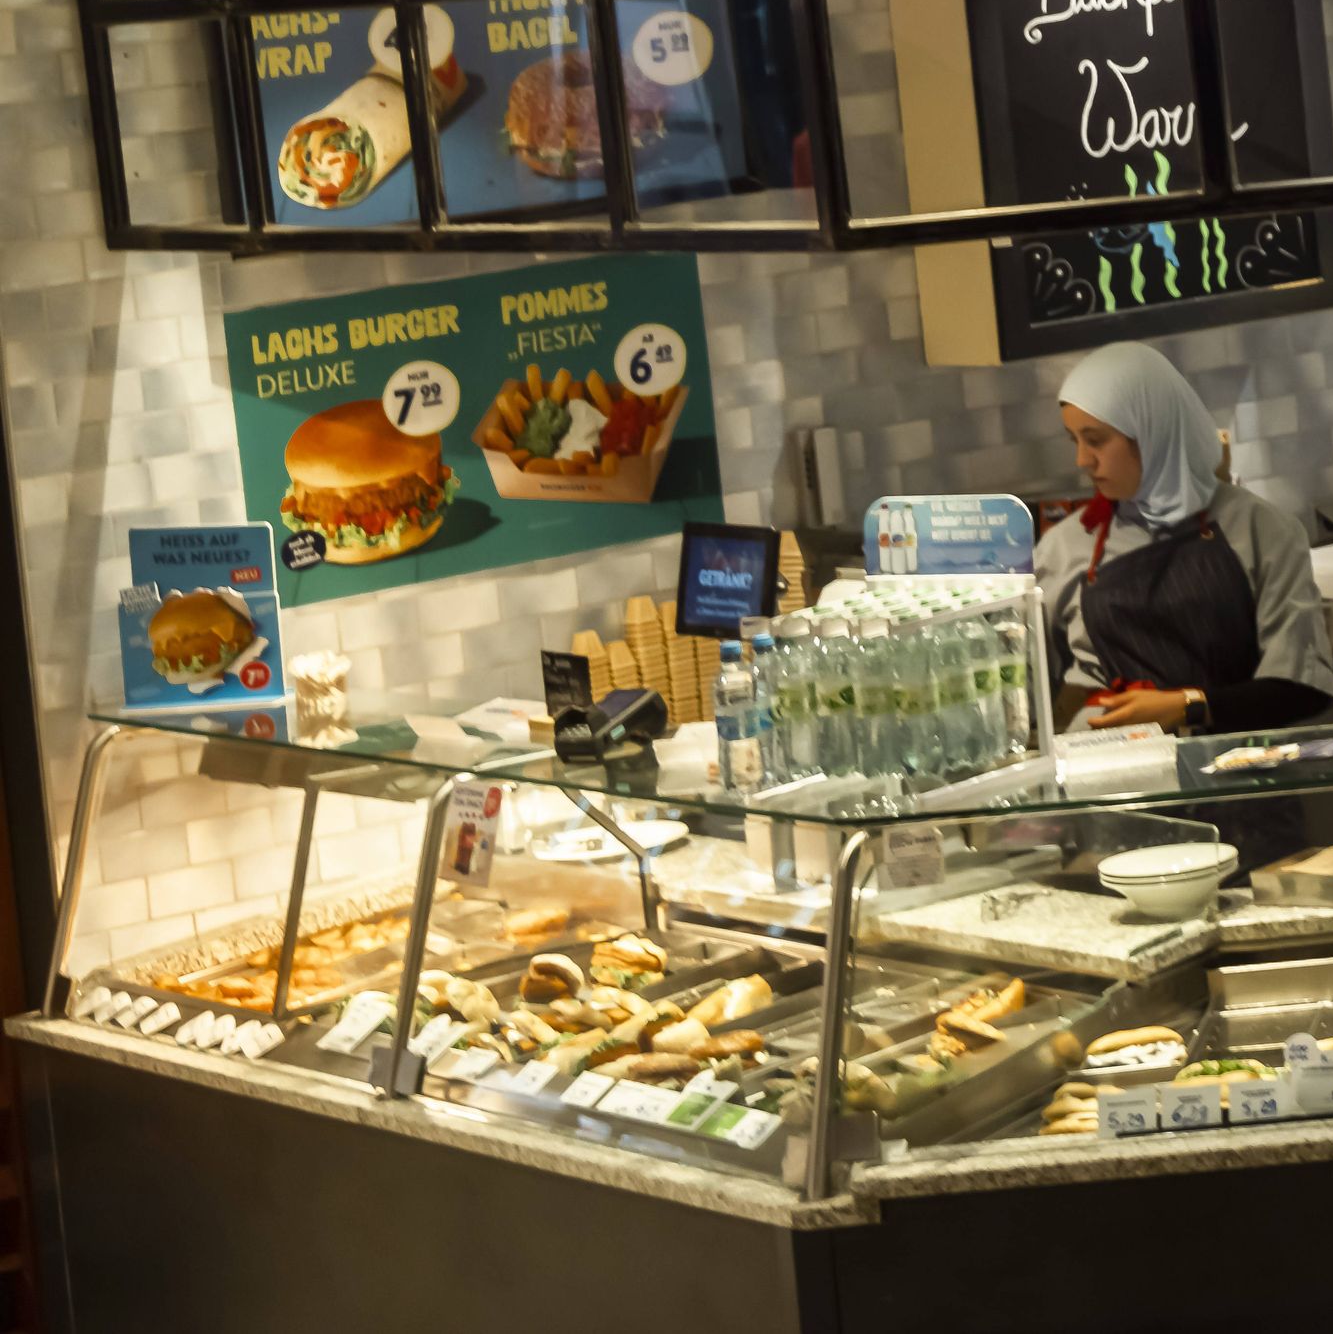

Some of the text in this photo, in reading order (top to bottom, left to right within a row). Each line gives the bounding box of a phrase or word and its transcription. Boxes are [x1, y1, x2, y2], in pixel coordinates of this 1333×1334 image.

[486, 16, 578, 54] BAGEL
[501, 281, 608, 325] POMMES
[251, 304, 461, 365] LACHS BURGER
[256, 359, 356, 400] DELUXE
[152, 551, 188, 565] WAS
[160, 532, 241, 548] HEISS AUF
[233, 571, 259, 584] NEU
